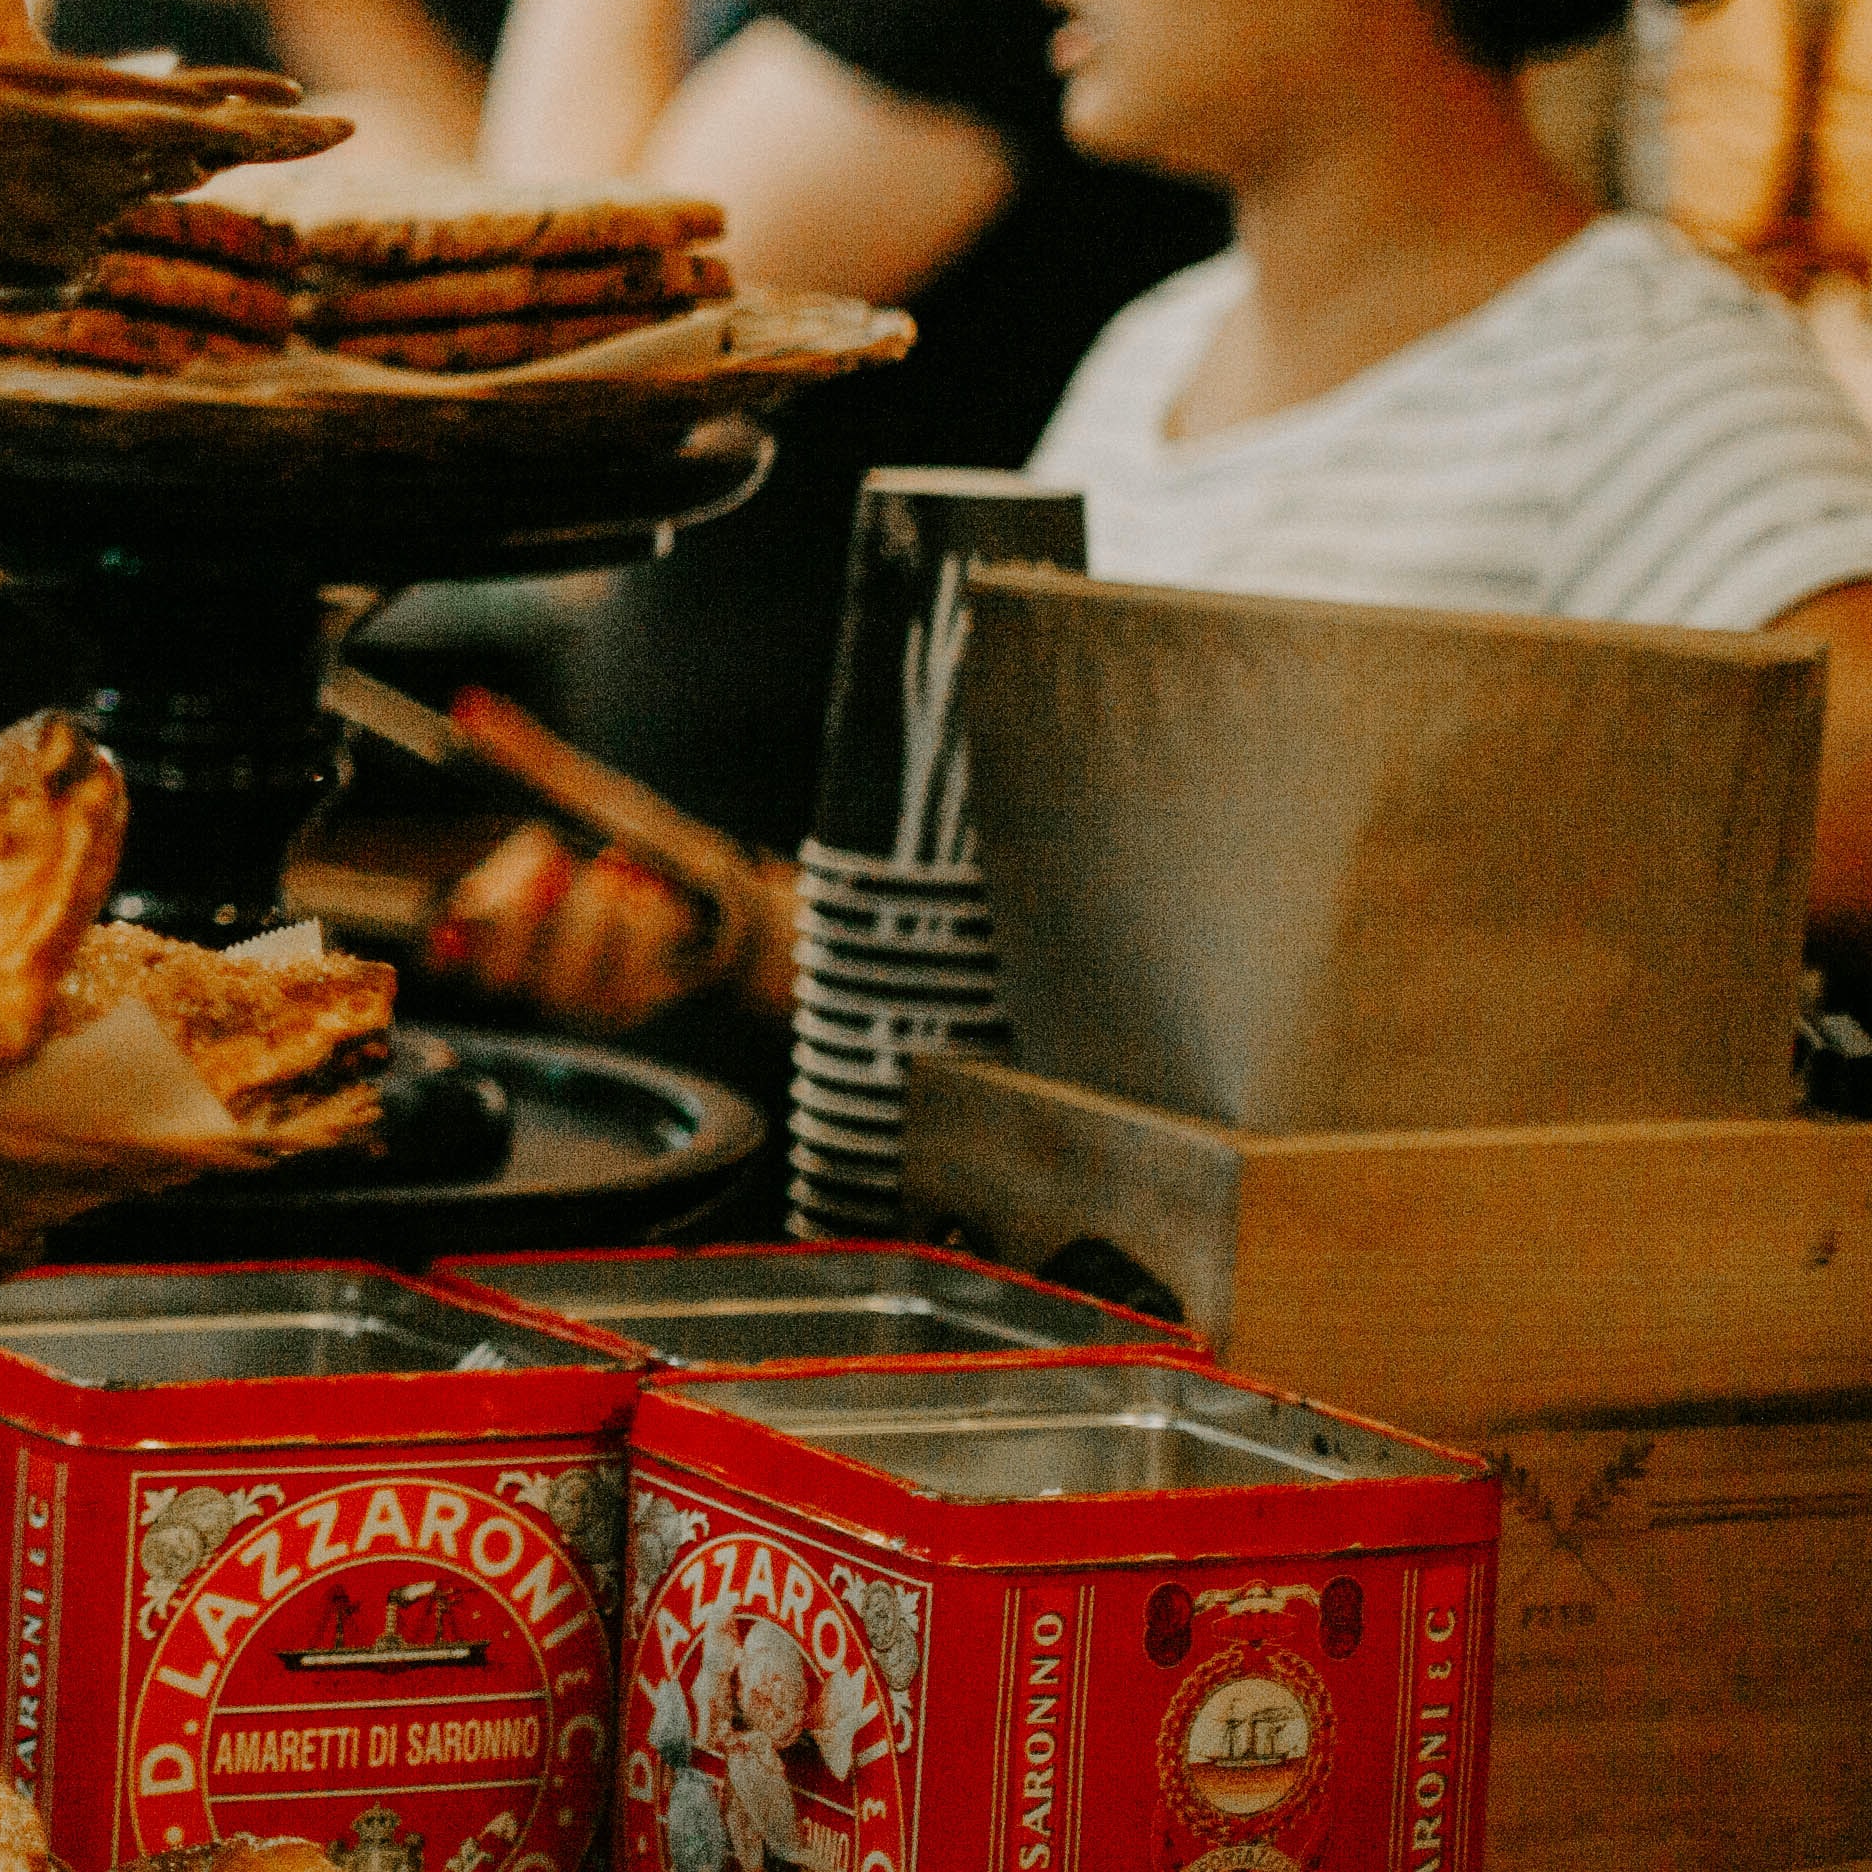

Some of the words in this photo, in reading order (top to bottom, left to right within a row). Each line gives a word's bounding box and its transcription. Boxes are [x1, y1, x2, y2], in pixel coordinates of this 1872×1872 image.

[157, 1489, 592, 1700] LAZZARONI
[213, 1728, 360, 1775] AMARETTI
[367, 1724, 399, 1769] DI
[407, 1715, 540, 1767] SARONNO
[1017, 1610, 1066, 1872] SARONNO
